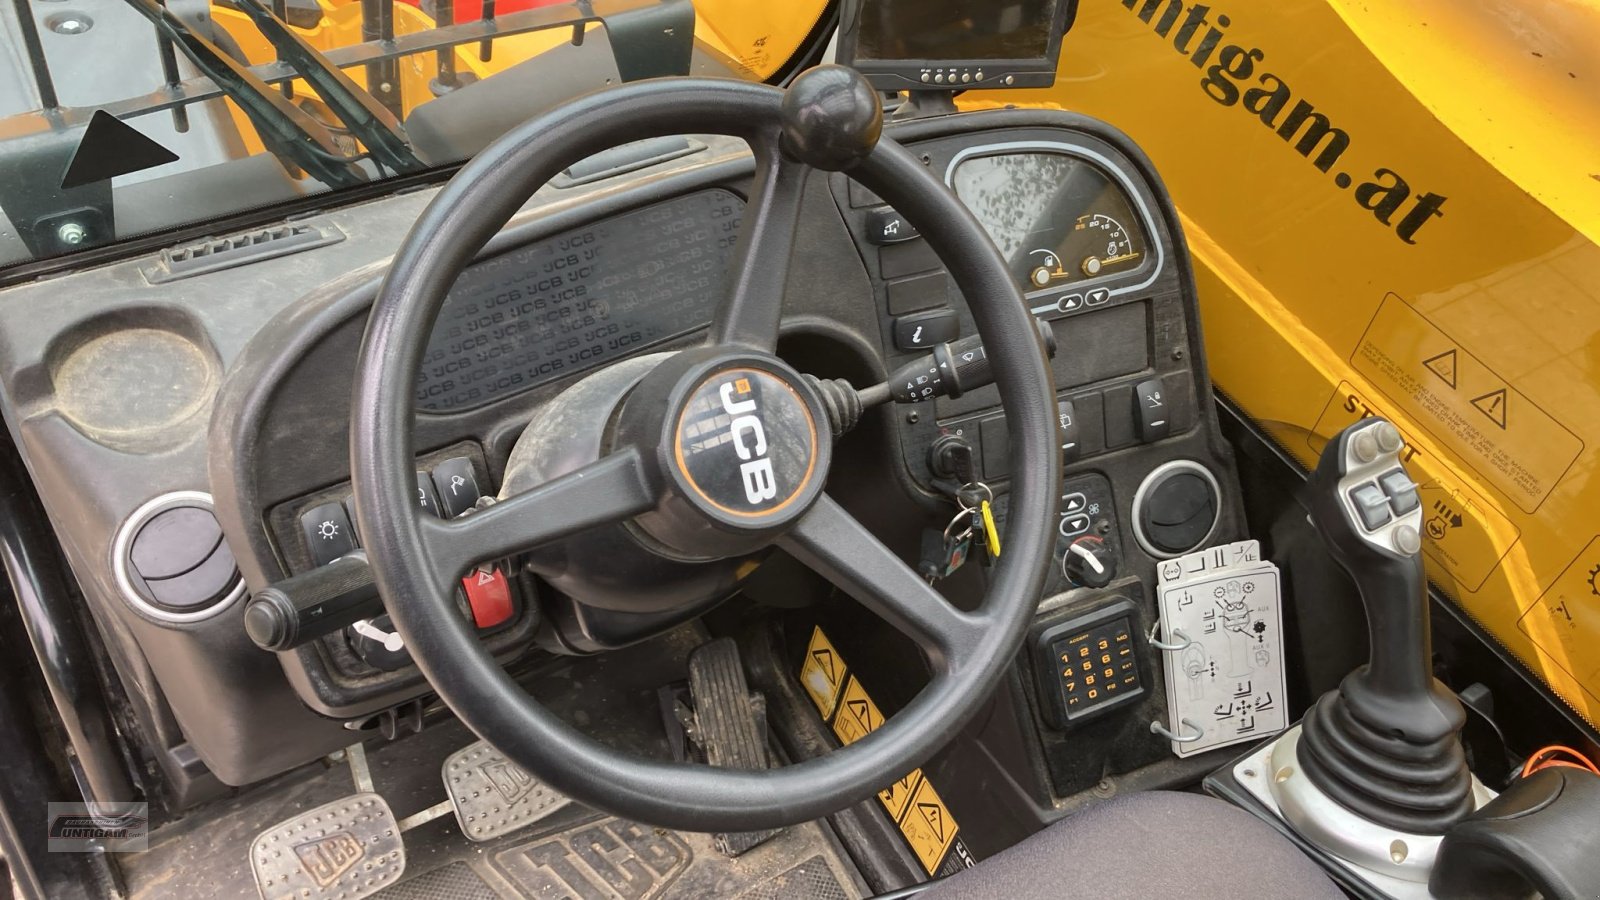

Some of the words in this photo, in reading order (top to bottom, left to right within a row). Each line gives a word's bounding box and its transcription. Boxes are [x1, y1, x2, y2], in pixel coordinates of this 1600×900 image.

[1121, 0, 1448, 245] ntigam.at
[529, 359, 564, 378] JCB
[569, 345, 603, 363] JCB
[609, 331, 642, 349] JCB
[719, 379, 777, 505] JCB
[1344, 394, 1421, 463] STT
[1415, 382, 1429, 394] AND
[1451, 411, 1495, 448] TEMPERATURE
[1510, 459, 1538, 483] MACHINE
[1478, 440, 1492, 452] AND
[1491, 451, 1508, 466] ONCE
[1510, 466, 1542, 494] STARTED
[1064, 668, 1073, 676] 4
[1083, 661, 1092, 671] 5
[1102, 654, 1110, 663] 6
[1080, 647, 1089, 657] 2
[1099, 640, 1108, 649] 3
[1067, 682, 1074, 691] 7
[1086, 675, 1095, 685] 8
[1104, 668, 1113, 677] 9
[1088, 689, 1097, 698] 0
